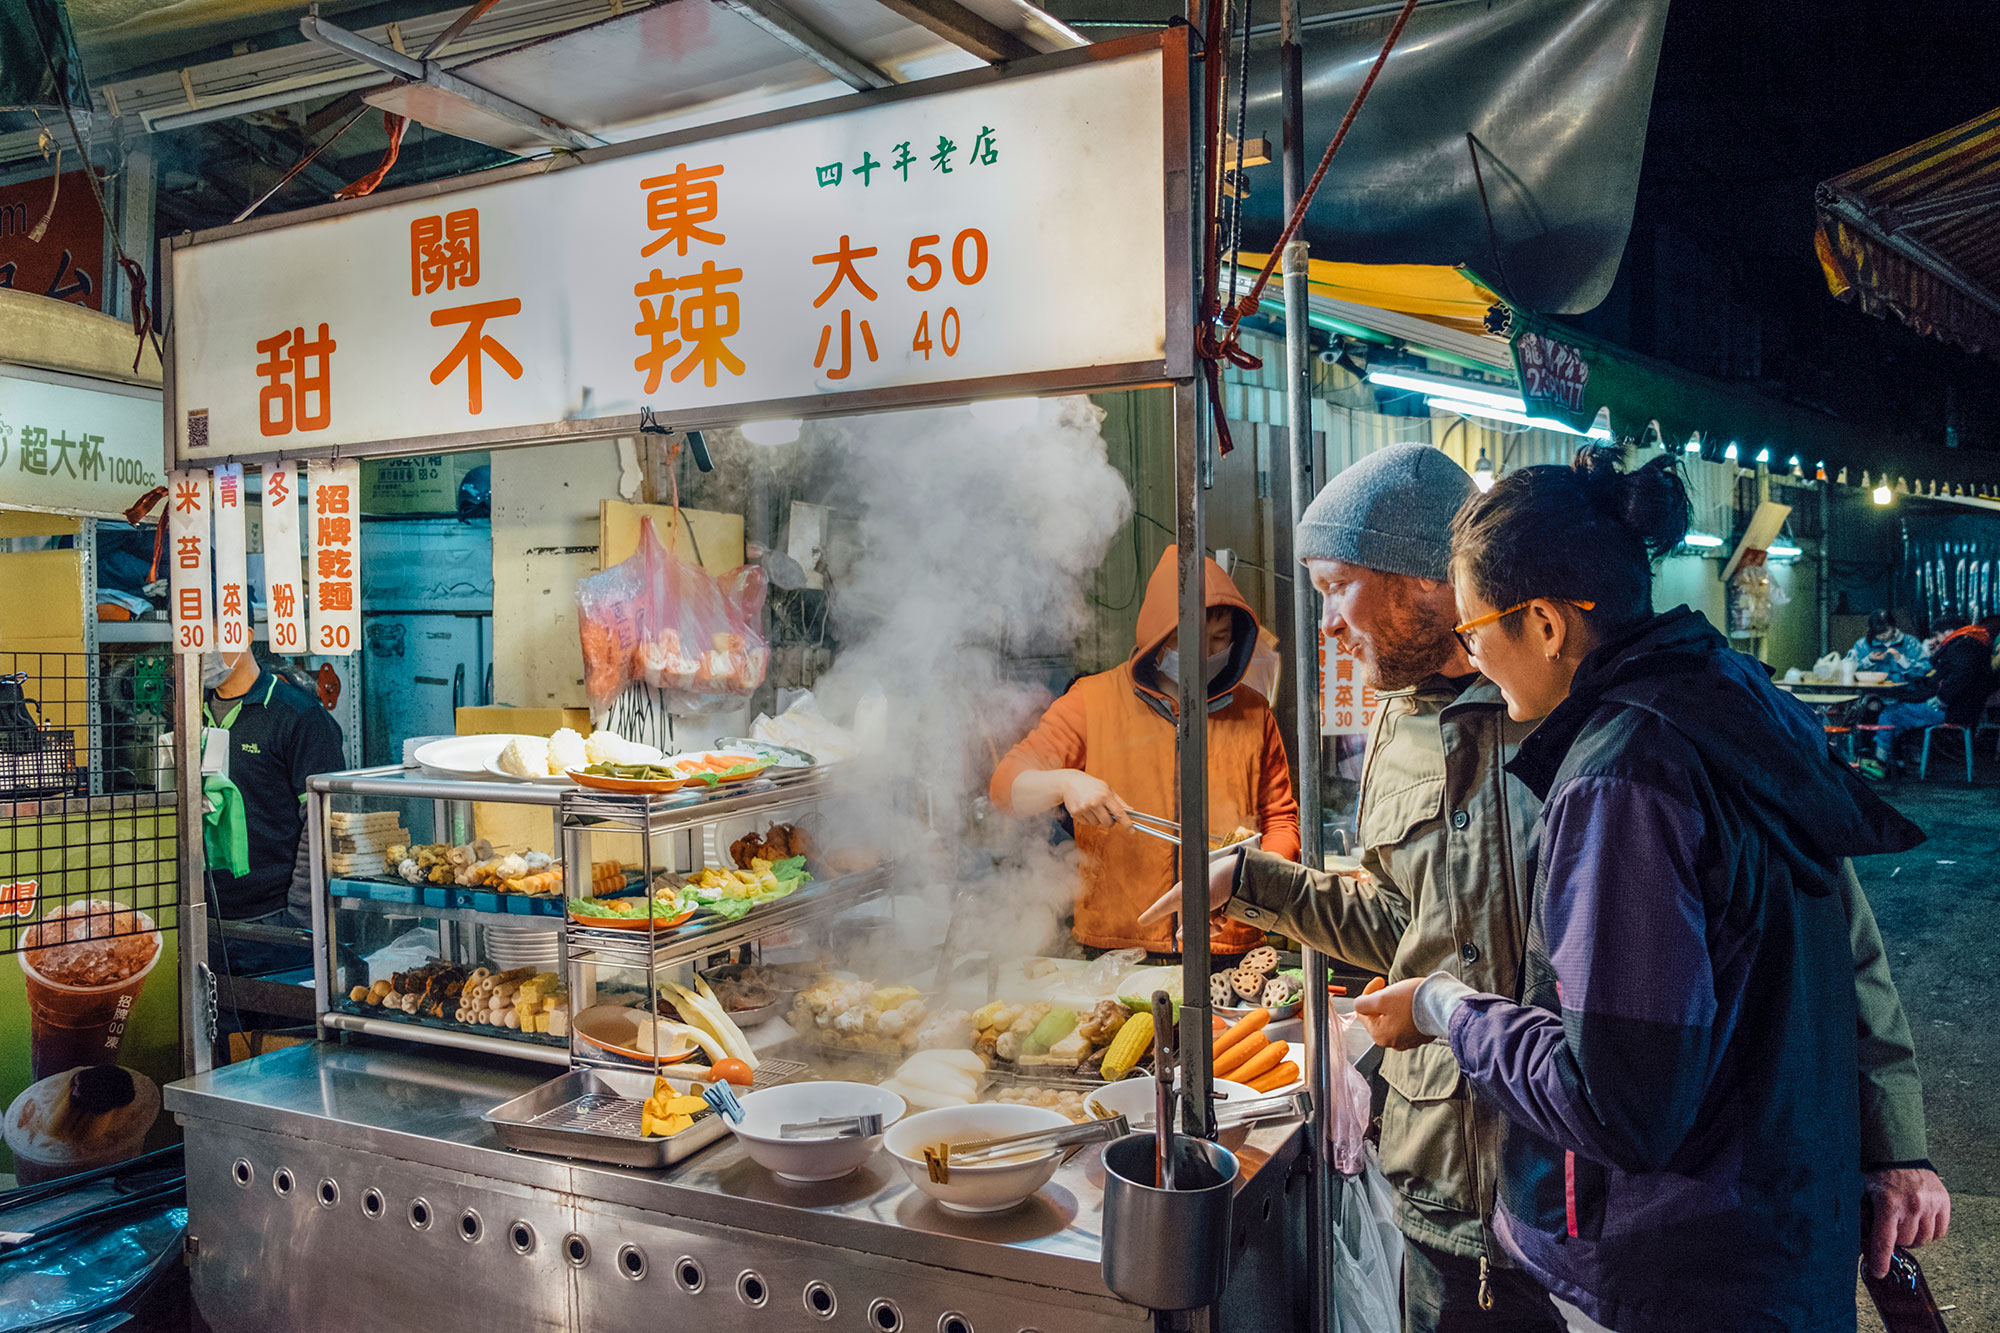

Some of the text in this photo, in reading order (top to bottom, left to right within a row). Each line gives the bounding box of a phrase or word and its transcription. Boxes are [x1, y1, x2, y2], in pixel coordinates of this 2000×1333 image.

[816, 126, 998, 188] 四十年老店
[812, 228, 989, 308] 大 50
[256, 260, 746, 437] 甜不辣
[813, 307, 961, 379] 小 40
[19, 424, 156, 487] 超大杯 1000cc
[176, 480, 203, 621] 米苔目
[220, 474, 242, 617] 青菜
[268, 472, 296, 618] 冬粉
[316, 485, 353, 611] 招牌乾麵
[180, 625, 204, 648] 30
[224, 622, 242, 645] 30
[275, 623, 297, 646] 30
[320, 625, 350, 648] 30
[1335, 711, 1353, 727] 30
